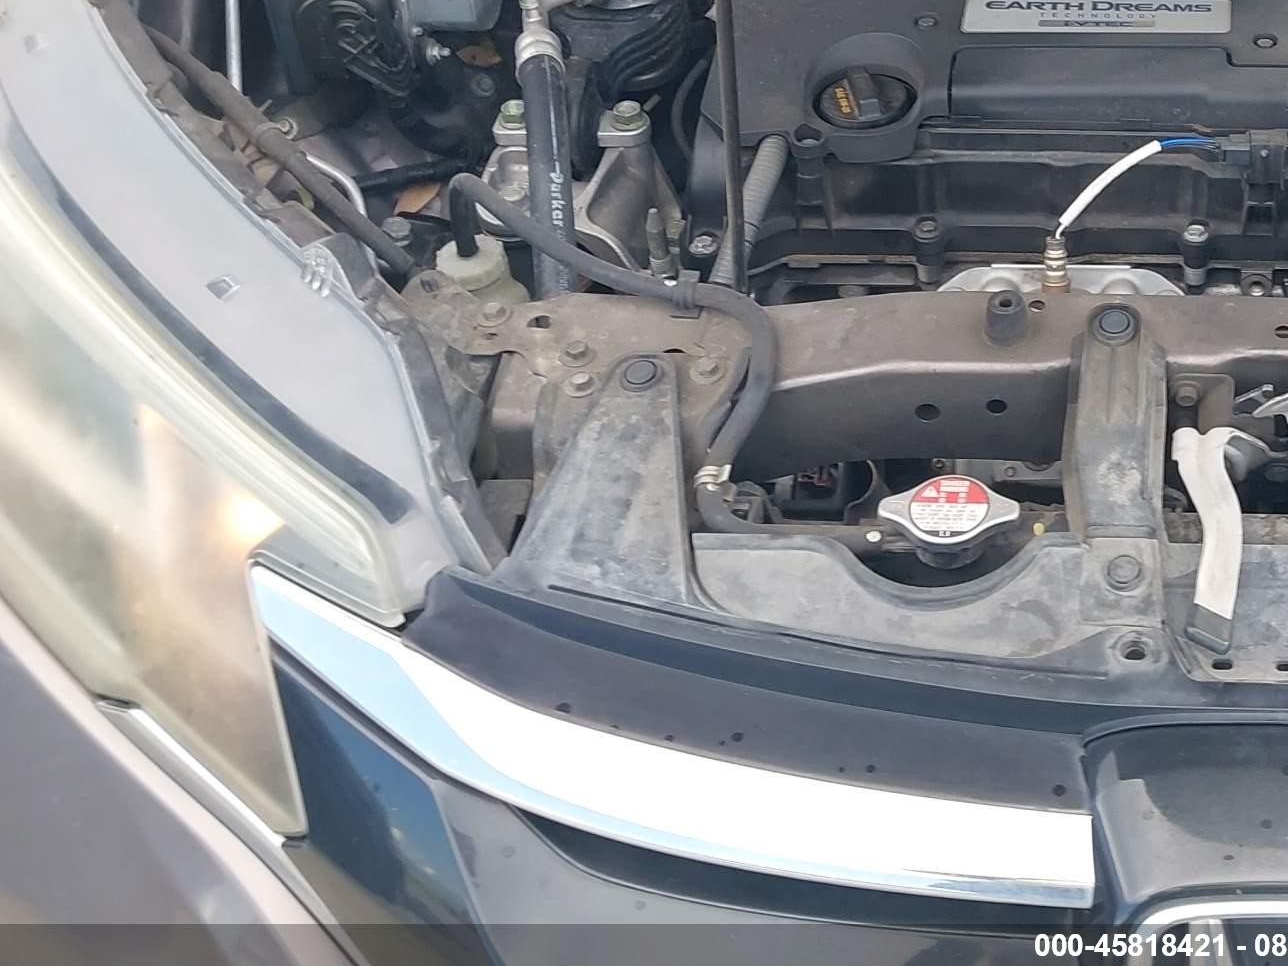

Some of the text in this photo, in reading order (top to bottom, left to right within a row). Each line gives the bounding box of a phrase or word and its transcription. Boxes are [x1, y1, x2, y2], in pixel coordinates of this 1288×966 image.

[985, 0, 1212, 14] EARTH DREAMS
[1040, 12, 1156, 20] TECHNOLOGY
[549, 172, 567, 228] Parker
